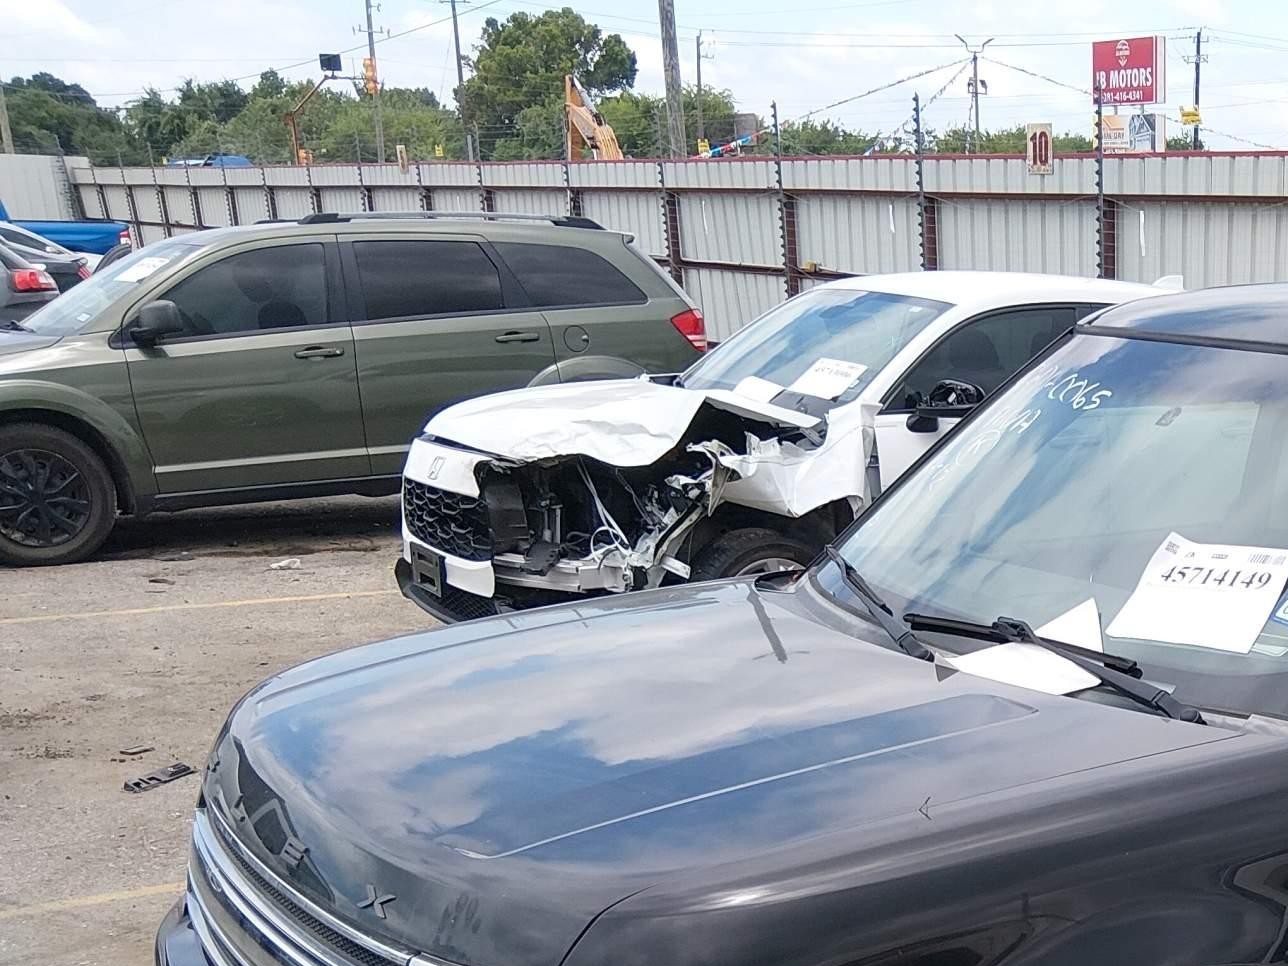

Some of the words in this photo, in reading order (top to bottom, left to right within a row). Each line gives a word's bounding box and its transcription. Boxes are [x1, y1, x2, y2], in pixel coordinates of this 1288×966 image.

[1110, 67, 1152, 89] MOTORS
[1030, 131, 1049, 166] 10
[1161, 566, 1272, 590] 45714149
